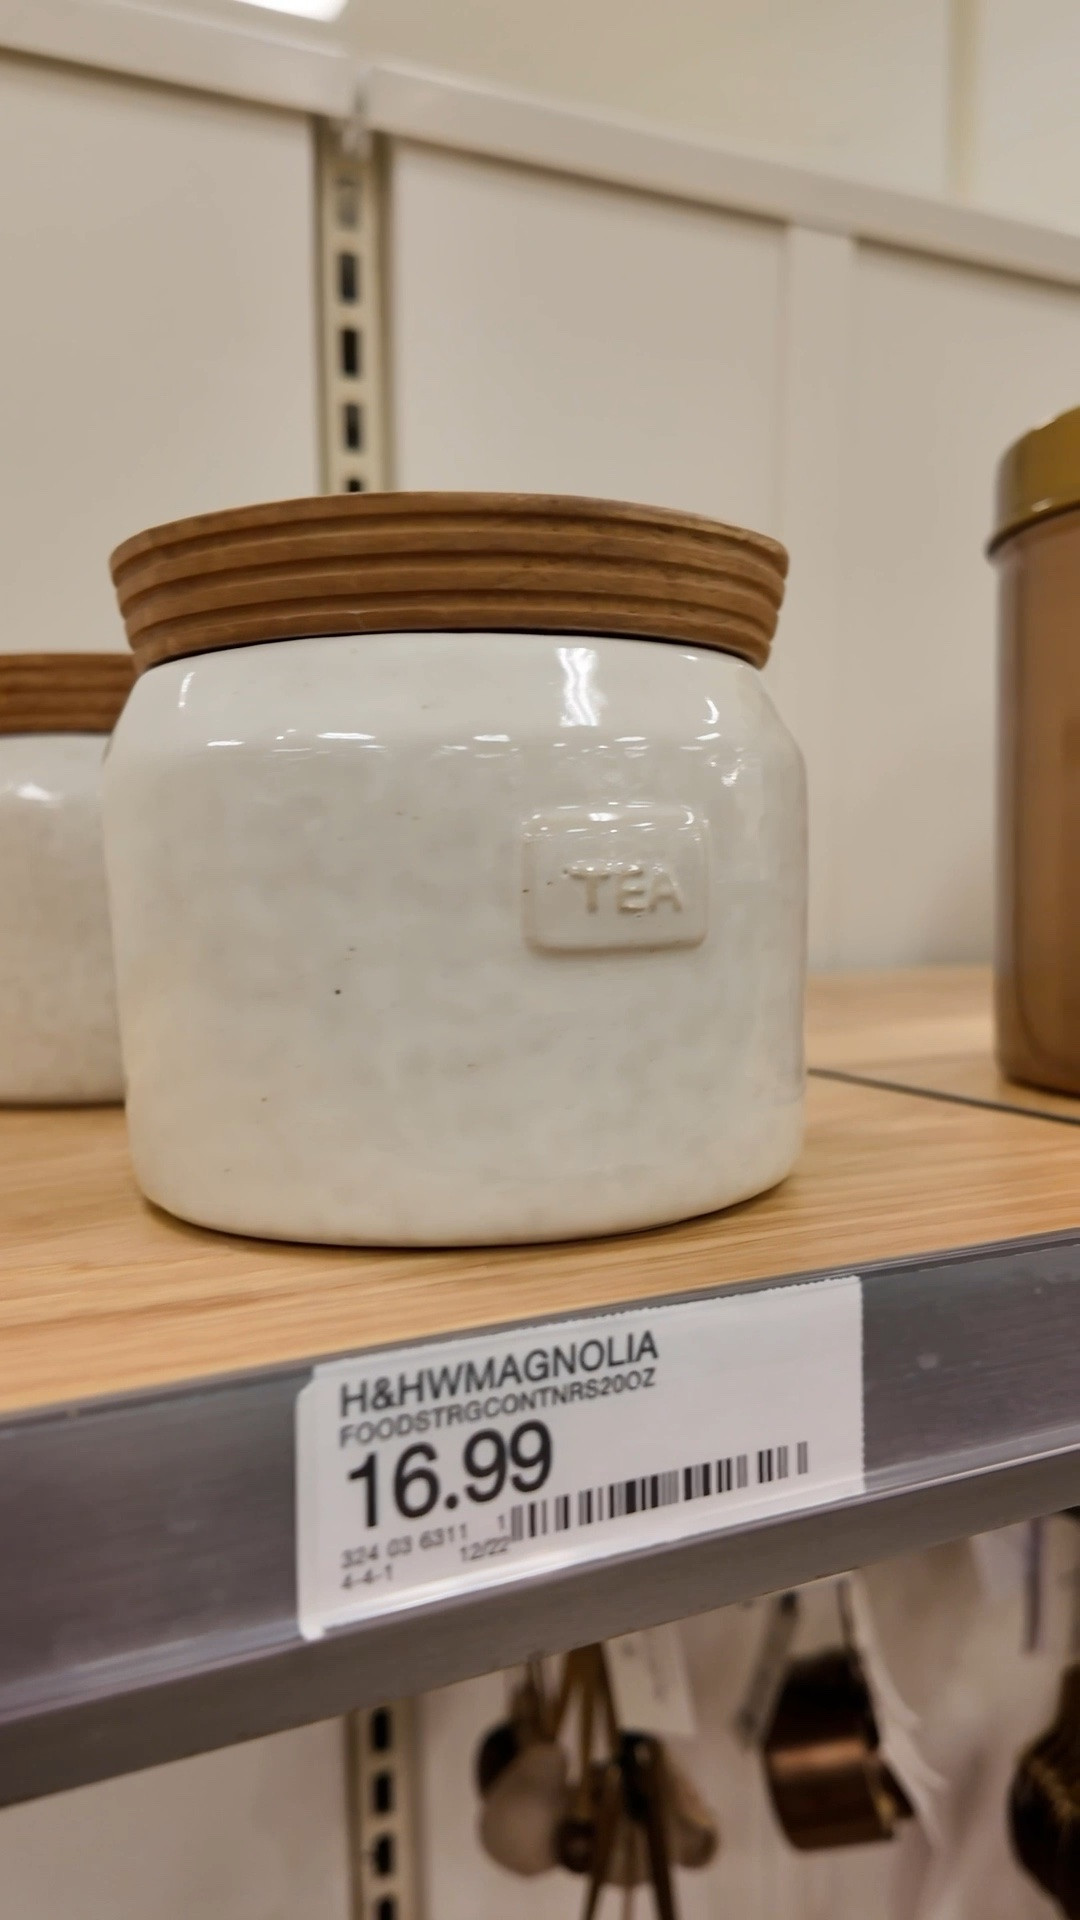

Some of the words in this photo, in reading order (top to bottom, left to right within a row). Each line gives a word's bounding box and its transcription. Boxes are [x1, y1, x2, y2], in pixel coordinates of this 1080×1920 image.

[567, 866, 682, 914] TEA
[339, 1329, 659, 1418] H&HWMAGNOLIA
[347, 1419, 552, 1528] 16.99
[341, 1544, 380, 1569] 324
[386, 1535, 414, 1558] 03
[419, 1523, 468, 1550] 6311
[460, 1535, 512, 1562] 12/22
[341, 1564, 394, 1590] 4-4-1
